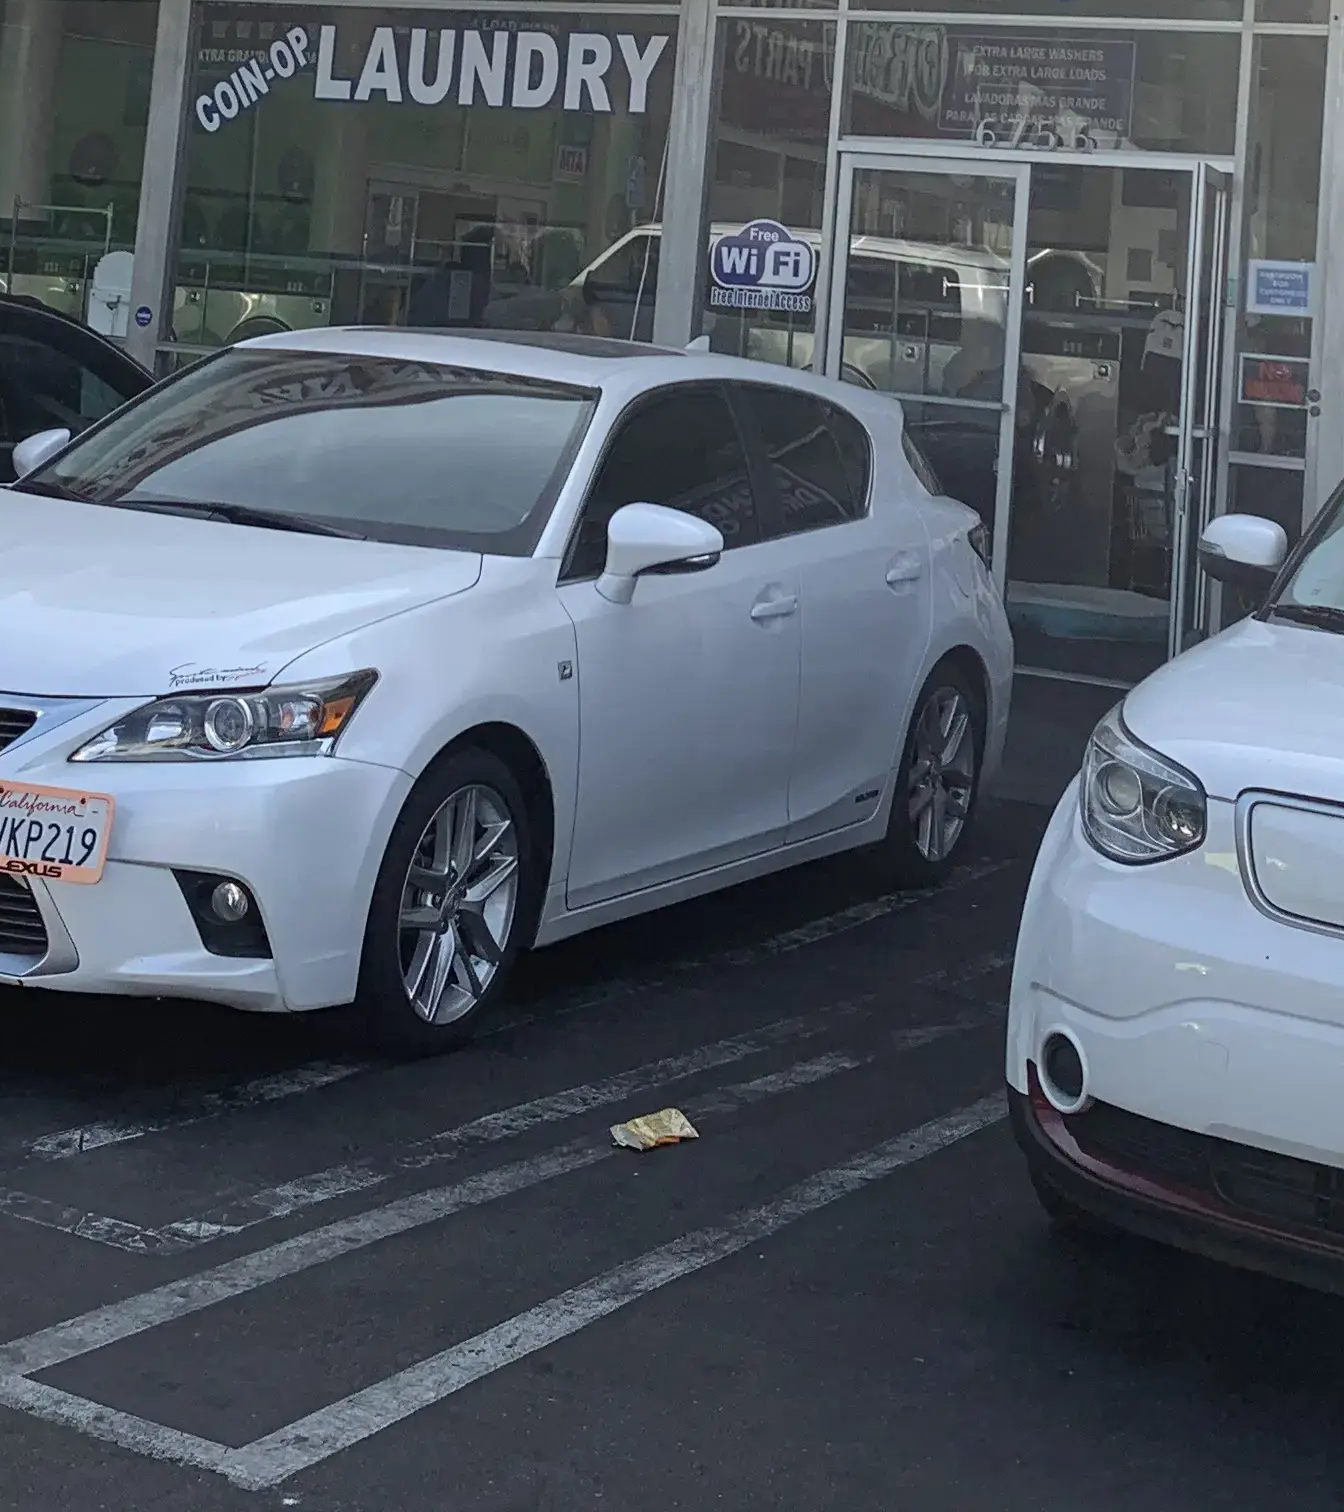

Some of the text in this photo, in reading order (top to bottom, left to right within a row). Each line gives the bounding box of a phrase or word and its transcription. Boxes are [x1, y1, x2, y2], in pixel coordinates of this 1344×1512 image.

[972, 46, 1104, 61] EXTRA LARGE WASHERS
[195, 24, 669, 132] COIN-OP LAUNDRY
[967, 65, 1106, 81] FOR EXTRA LARGE LOADS
[750, 228, 779, 241] Free
[711, 287, 811, 311] Free Internet Access
[0, 790, 85, 817] California
